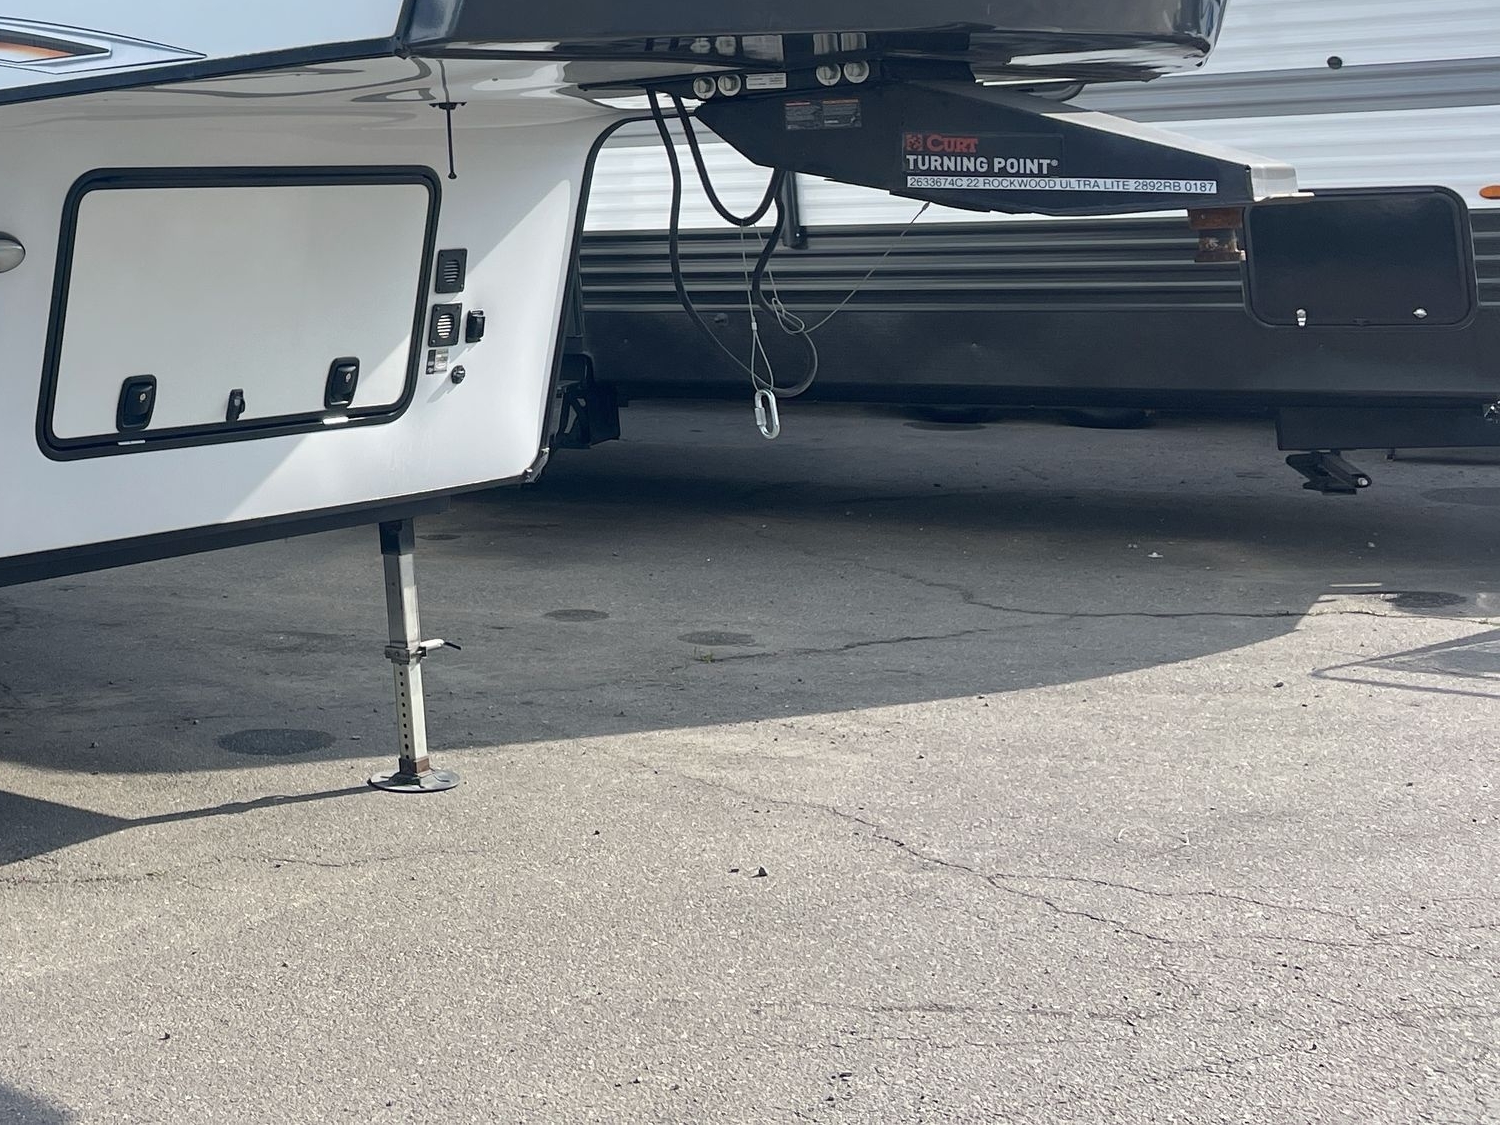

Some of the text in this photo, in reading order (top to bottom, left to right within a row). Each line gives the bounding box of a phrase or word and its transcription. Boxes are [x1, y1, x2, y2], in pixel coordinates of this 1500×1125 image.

[926, 134, 978, 153] CURT
[906, 155, 989, 172] TURNING
[909, 177, 1214, 193] 2633674C 22 ROCKWOOD ULTRA LITE 2892RB 0187
